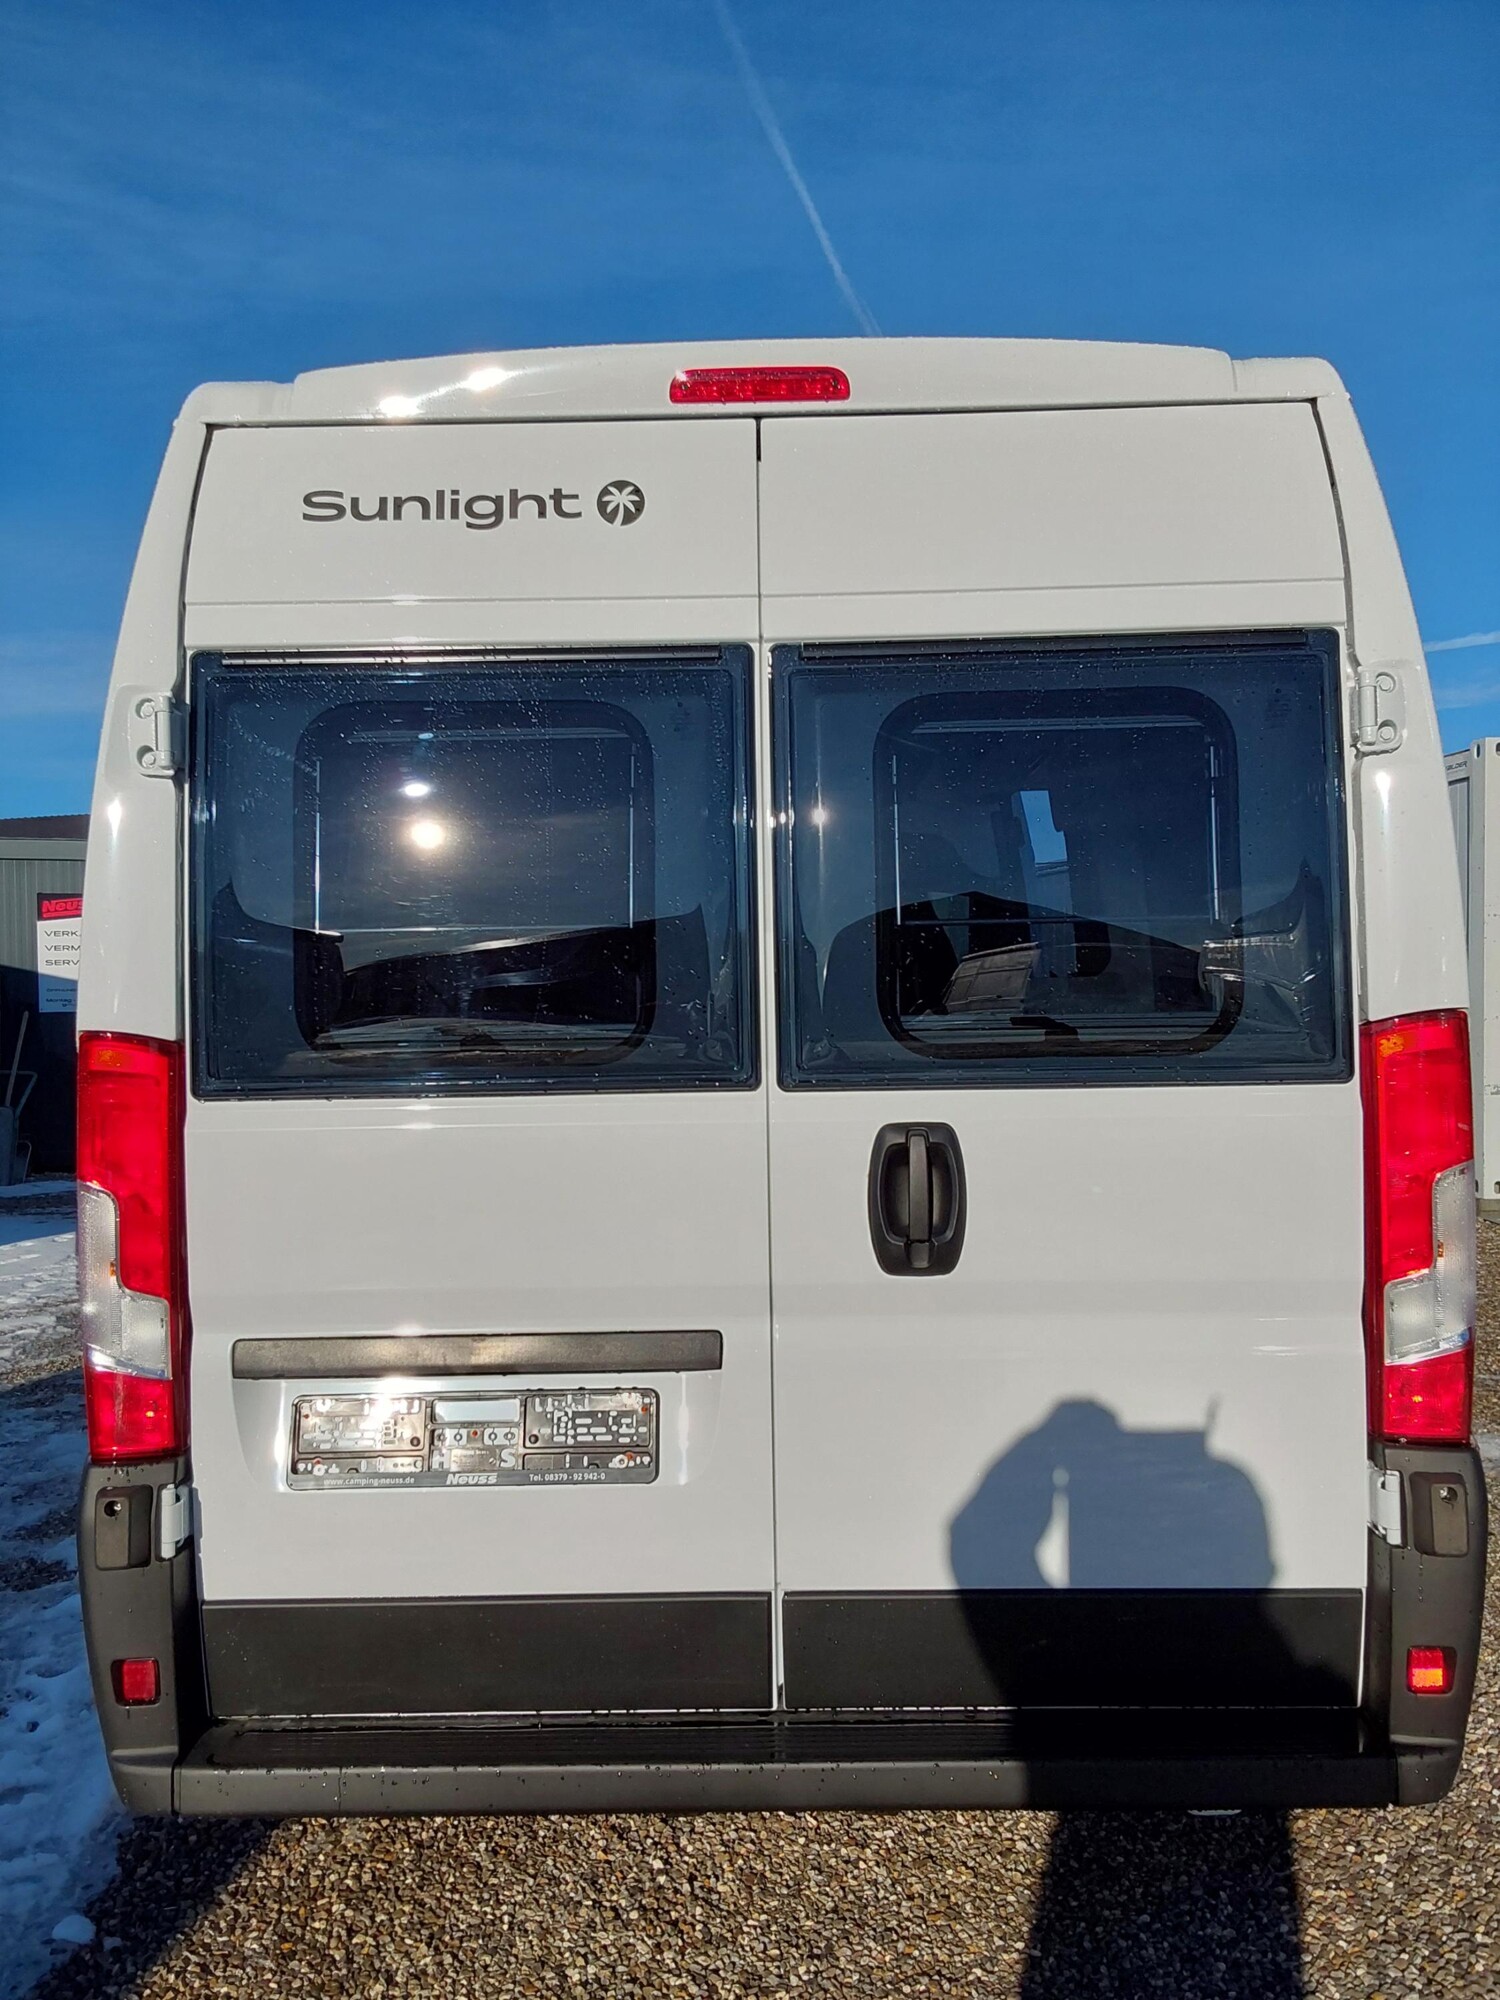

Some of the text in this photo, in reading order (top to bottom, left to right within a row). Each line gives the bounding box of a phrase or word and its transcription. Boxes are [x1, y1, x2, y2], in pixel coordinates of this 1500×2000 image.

[302, 488, 583, 531] Sunlight
[323, 1476, 415, 1486] www.camping-neuss.de
[529, 1474, 544, 1482] Tel.
[544, 1473, 568, 1481] 08379
